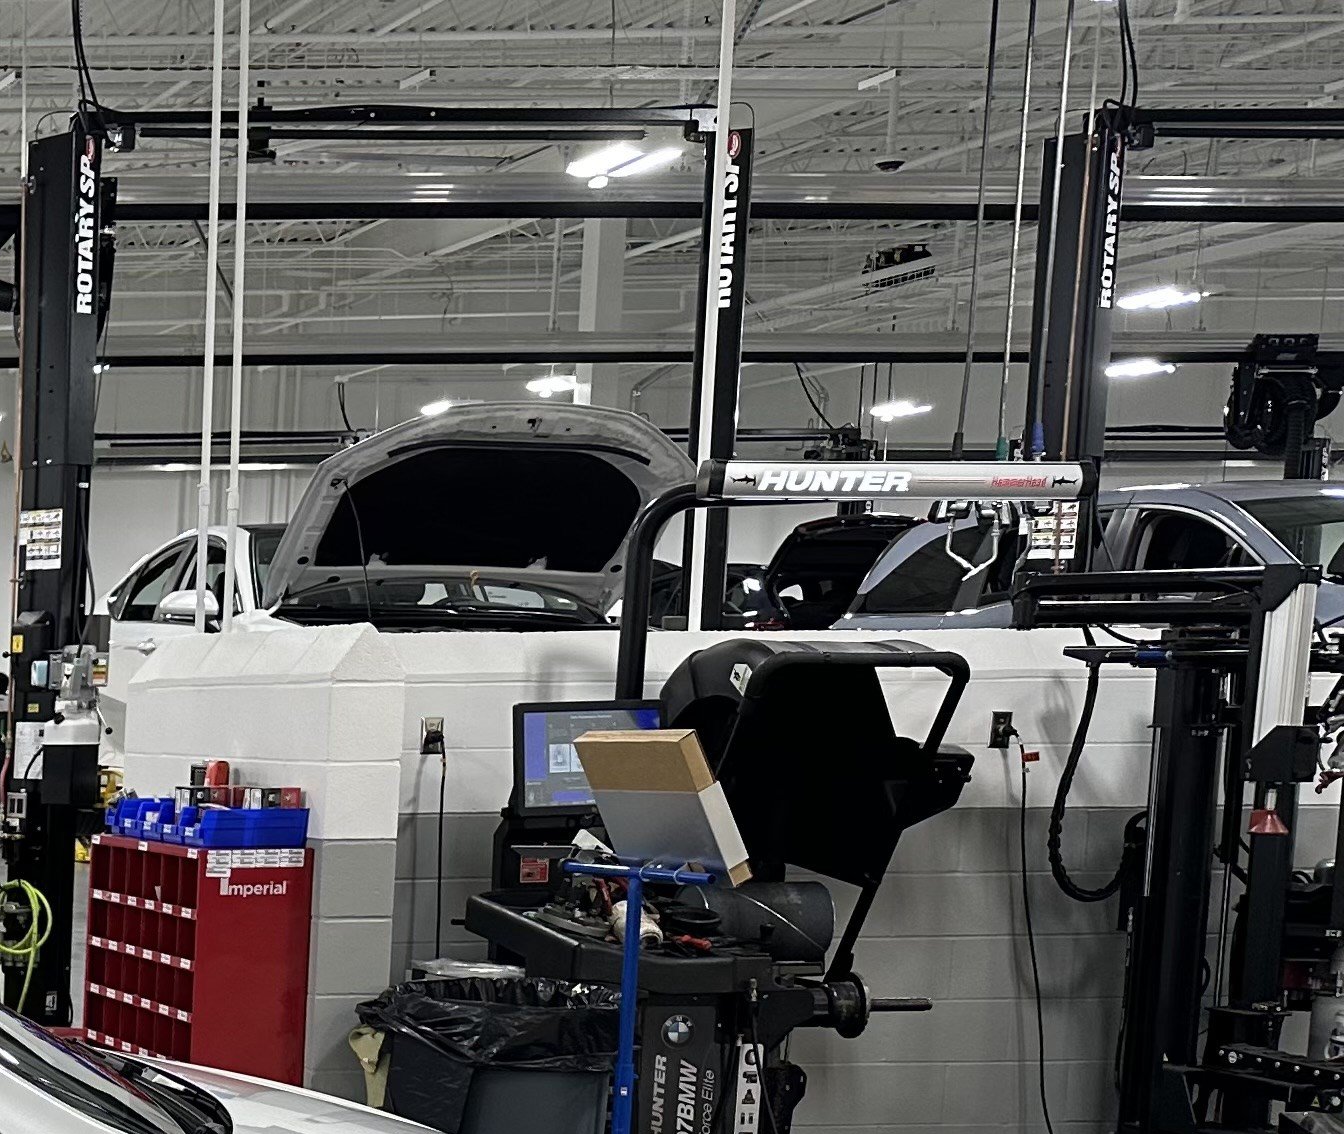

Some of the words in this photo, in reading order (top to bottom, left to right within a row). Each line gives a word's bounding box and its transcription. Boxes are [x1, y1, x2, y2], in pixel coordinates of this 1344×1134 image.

[80, 155, 96, 198] SP
[1100, 194, 1118, 309] ROTARY
[1109, 152, 1121, 195] SP
[76, 198, 94, 314] ROTARY
[757, 471, 912, 492] HUNTER
[220, 877, 287, 898] Imperial
[701, 1069, 715, 1101] Elite
